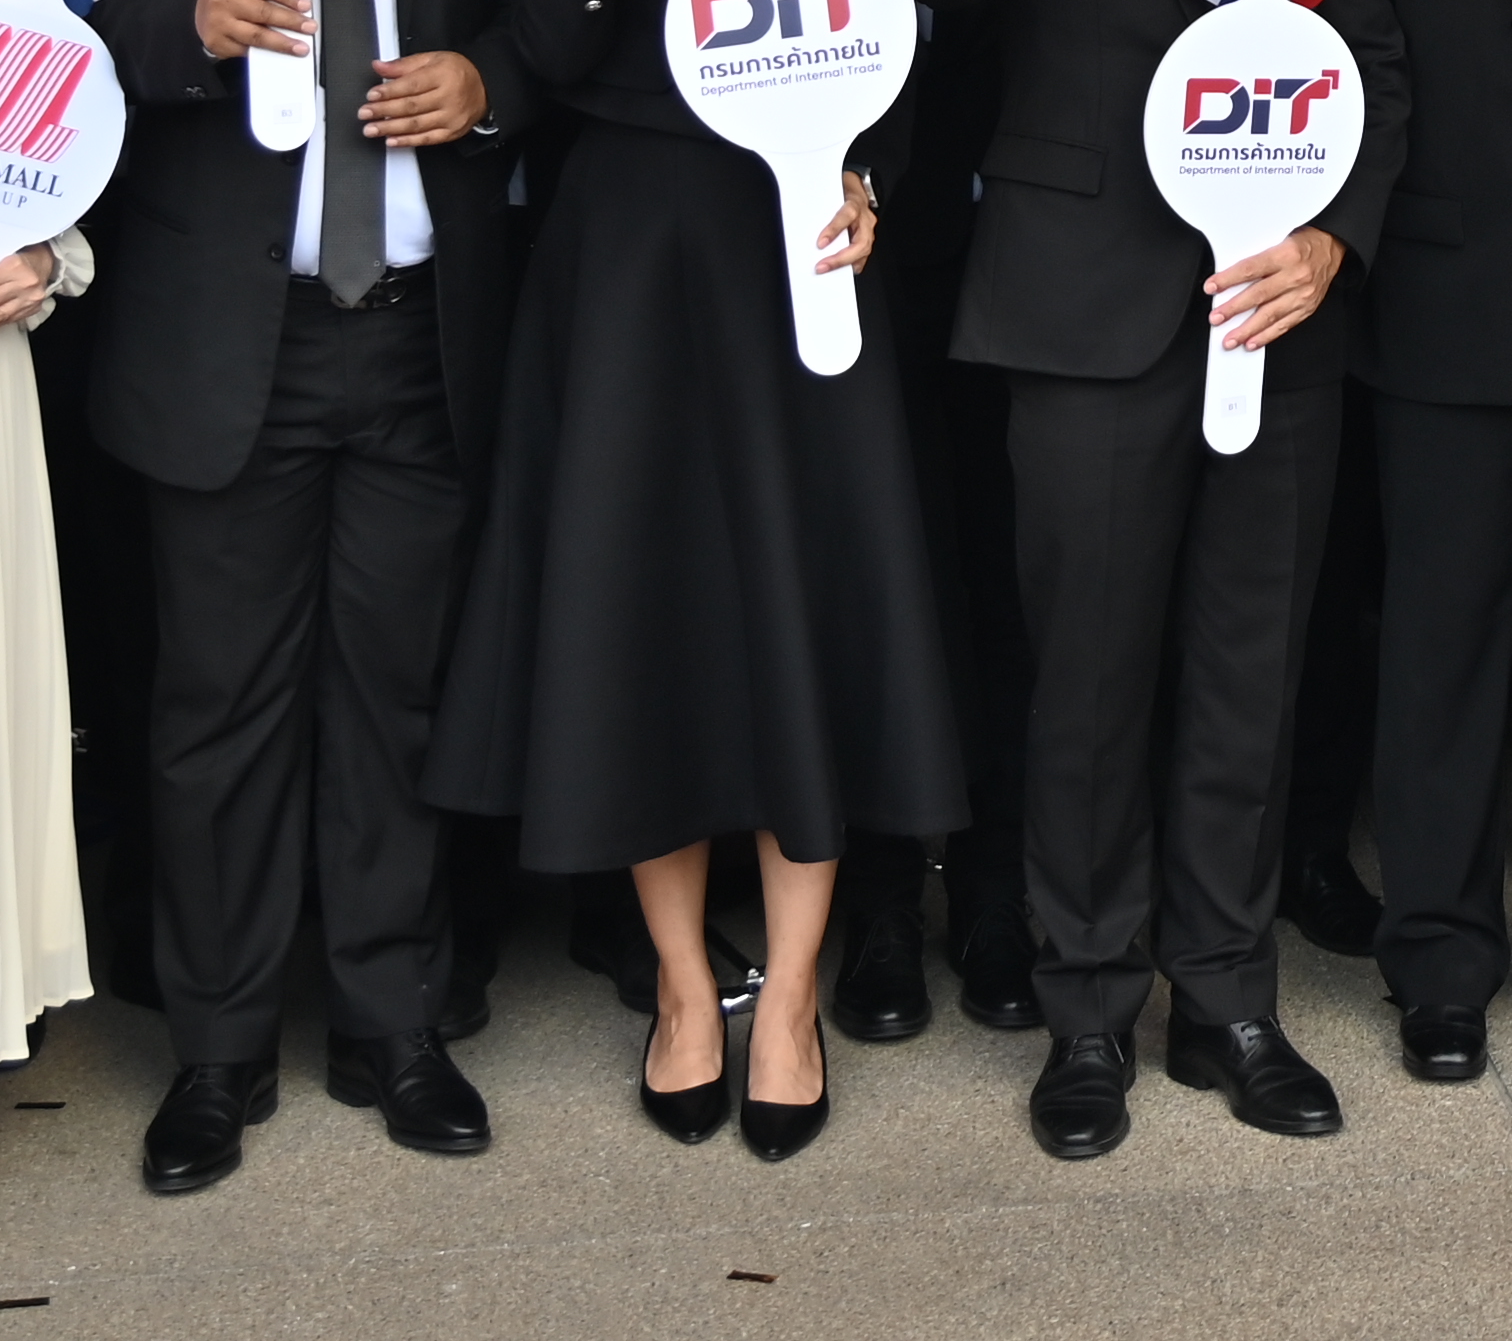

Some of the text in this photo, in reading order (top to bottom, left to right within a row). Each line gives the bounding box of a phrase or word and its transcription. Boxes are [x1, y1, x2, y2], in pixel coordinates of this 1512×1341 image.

[698, 39, 882, 81] กรมการค้าภายใน
[700, 61, 884, 98] Department of Internal Trade
[1181, 143, 1326, 163] กรมการค้าภายใน
[1179, 165, 1326, 178] Department of Internal Trade
